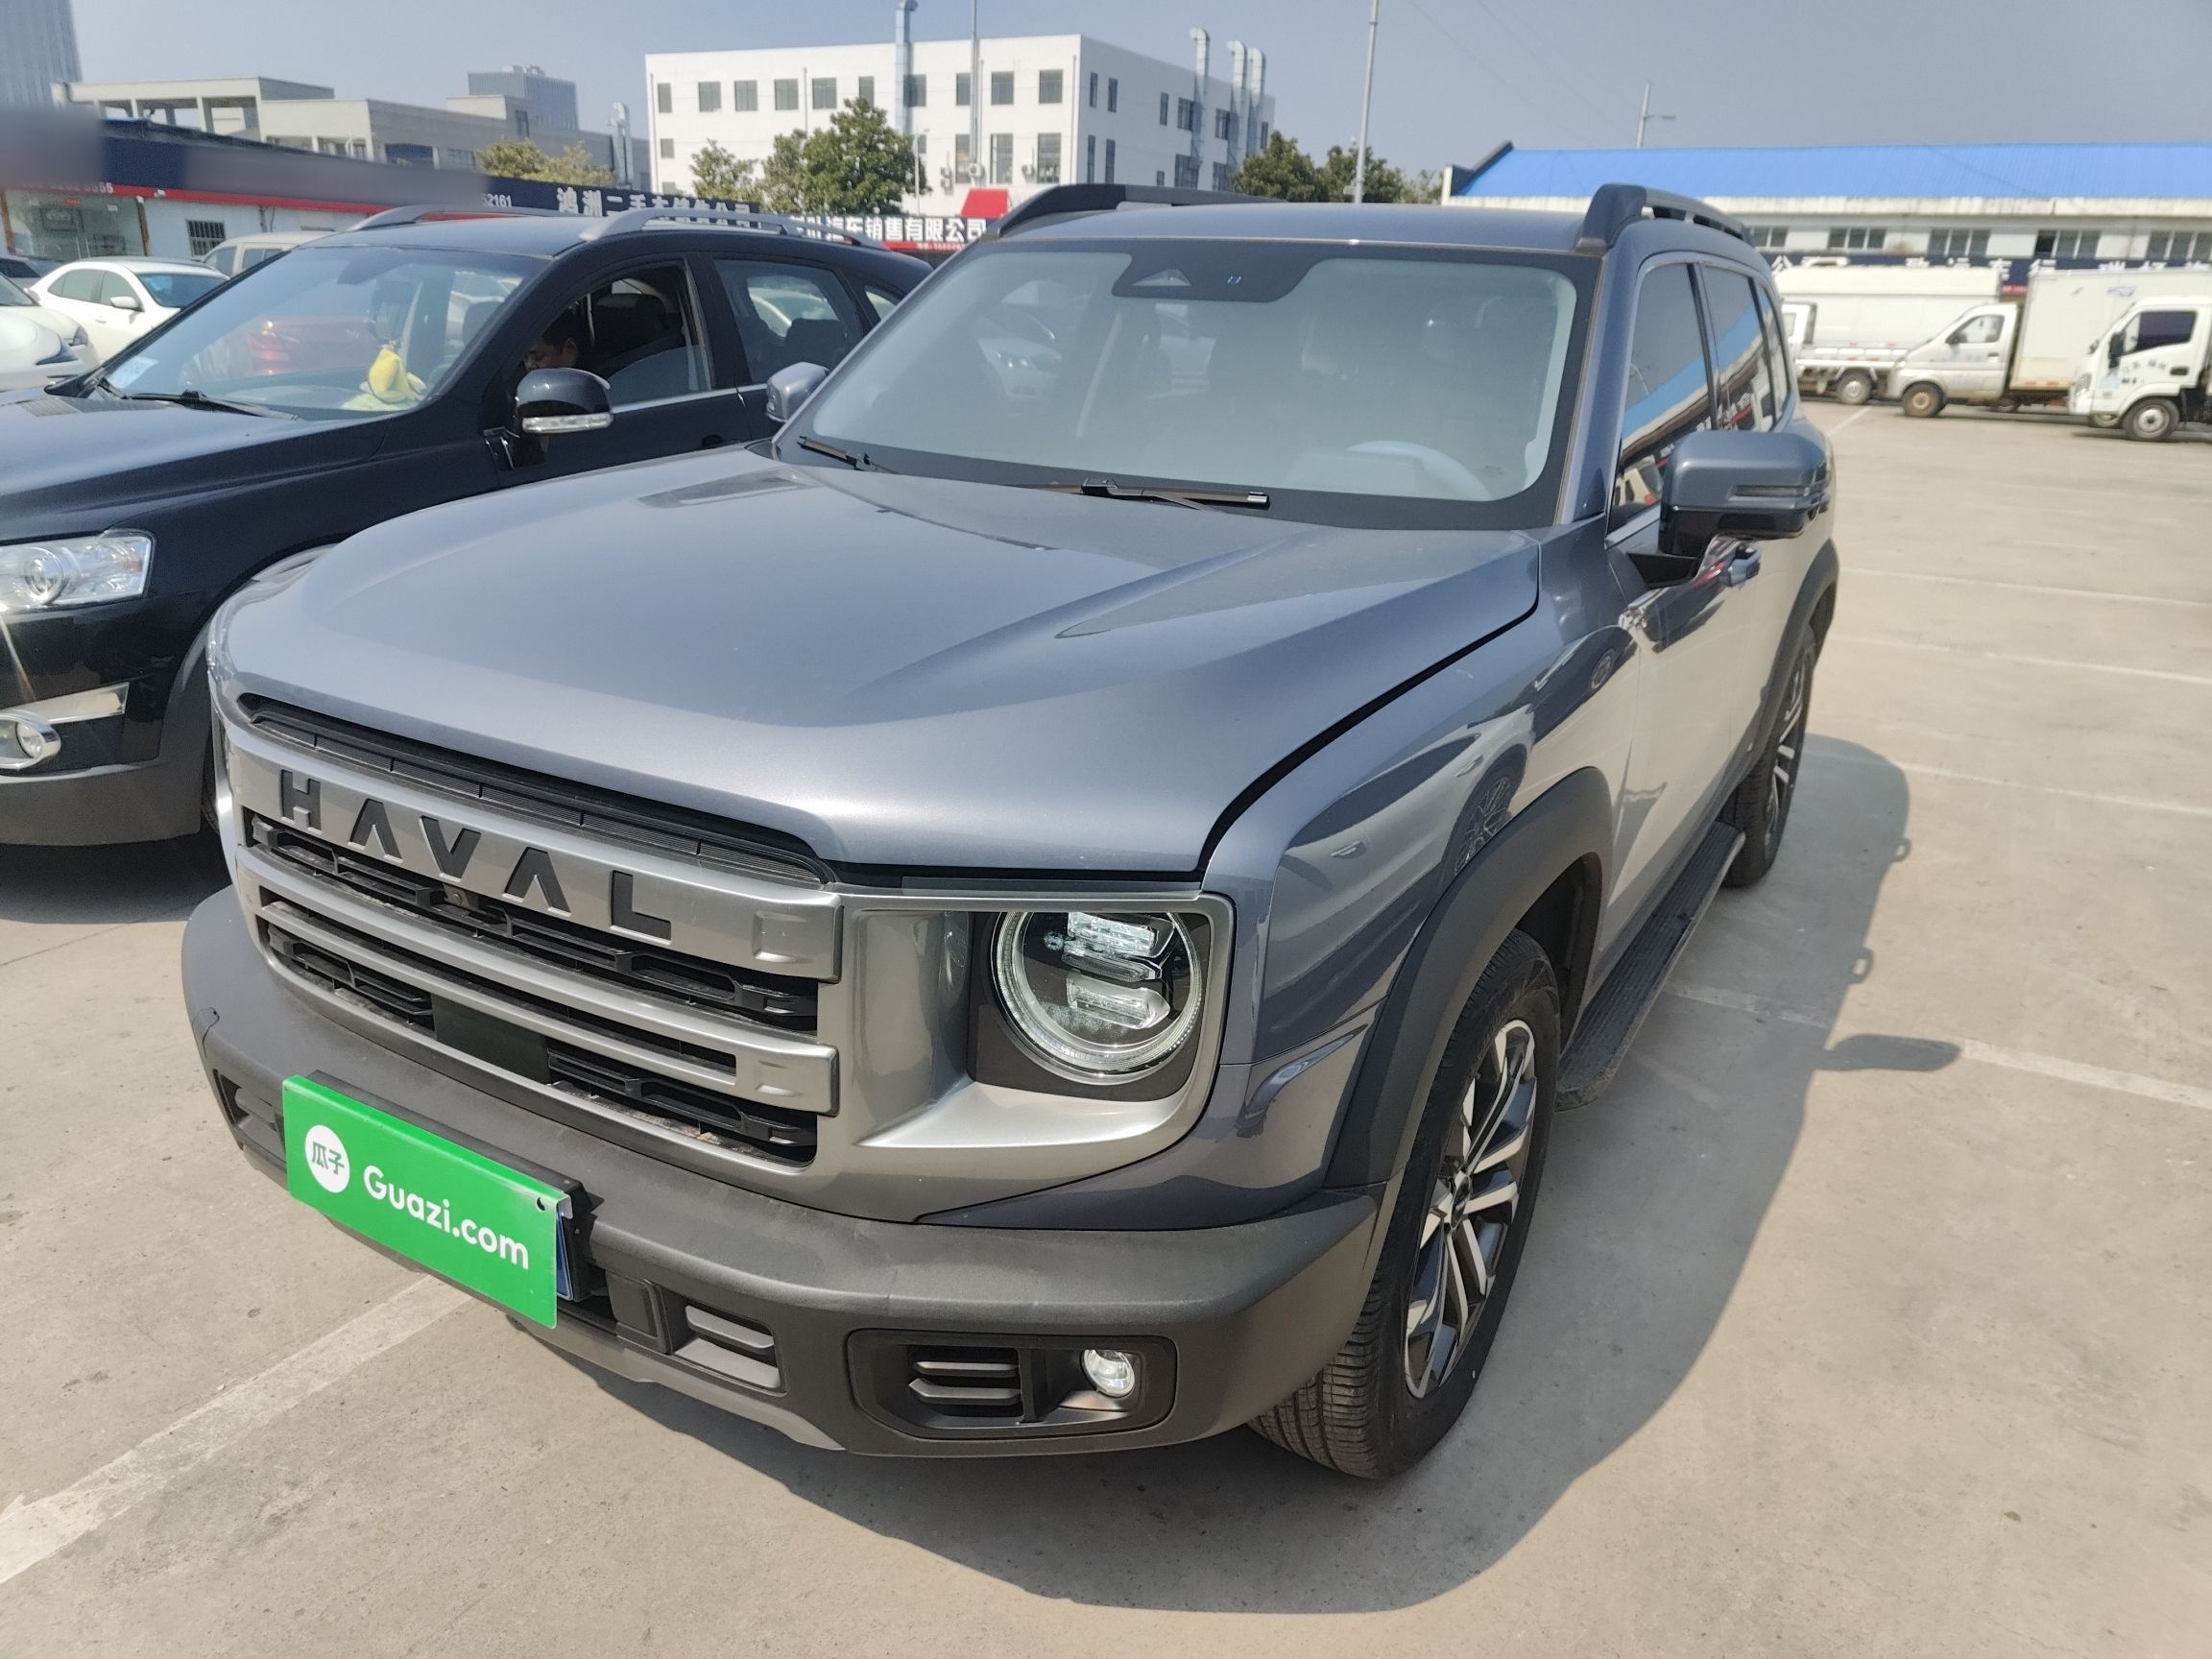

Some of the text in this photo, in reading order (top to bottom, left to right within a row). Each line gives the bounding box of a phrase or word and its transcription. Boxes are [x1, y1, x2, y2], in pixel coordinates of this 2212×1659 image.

[278, 769, 672, 944] HAVAL
[312, 1142, 345, 1175] 瓜子
[364, 1165, 529, 1270] Guazi.com
